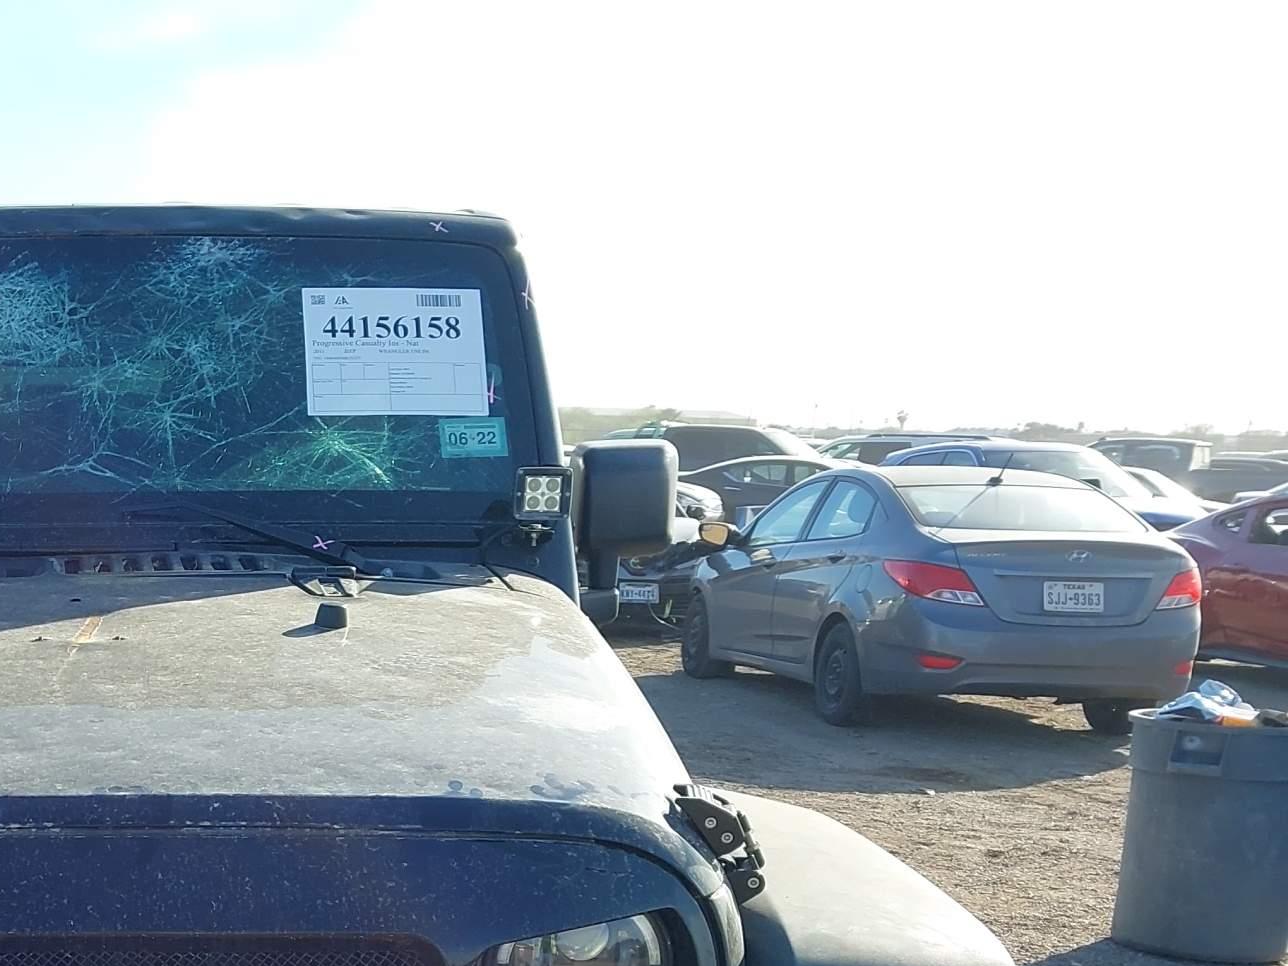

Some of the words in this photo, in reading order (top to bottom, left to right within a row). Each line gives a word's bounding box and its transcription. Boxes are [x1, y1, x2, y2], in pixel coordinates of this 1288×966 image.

[322, 315, 462, 339] 44156158
[311, 339, 354, 348] Progressive
[355, 339, 387, 348] Casualty
[406, 339, 420, 347] Nat
